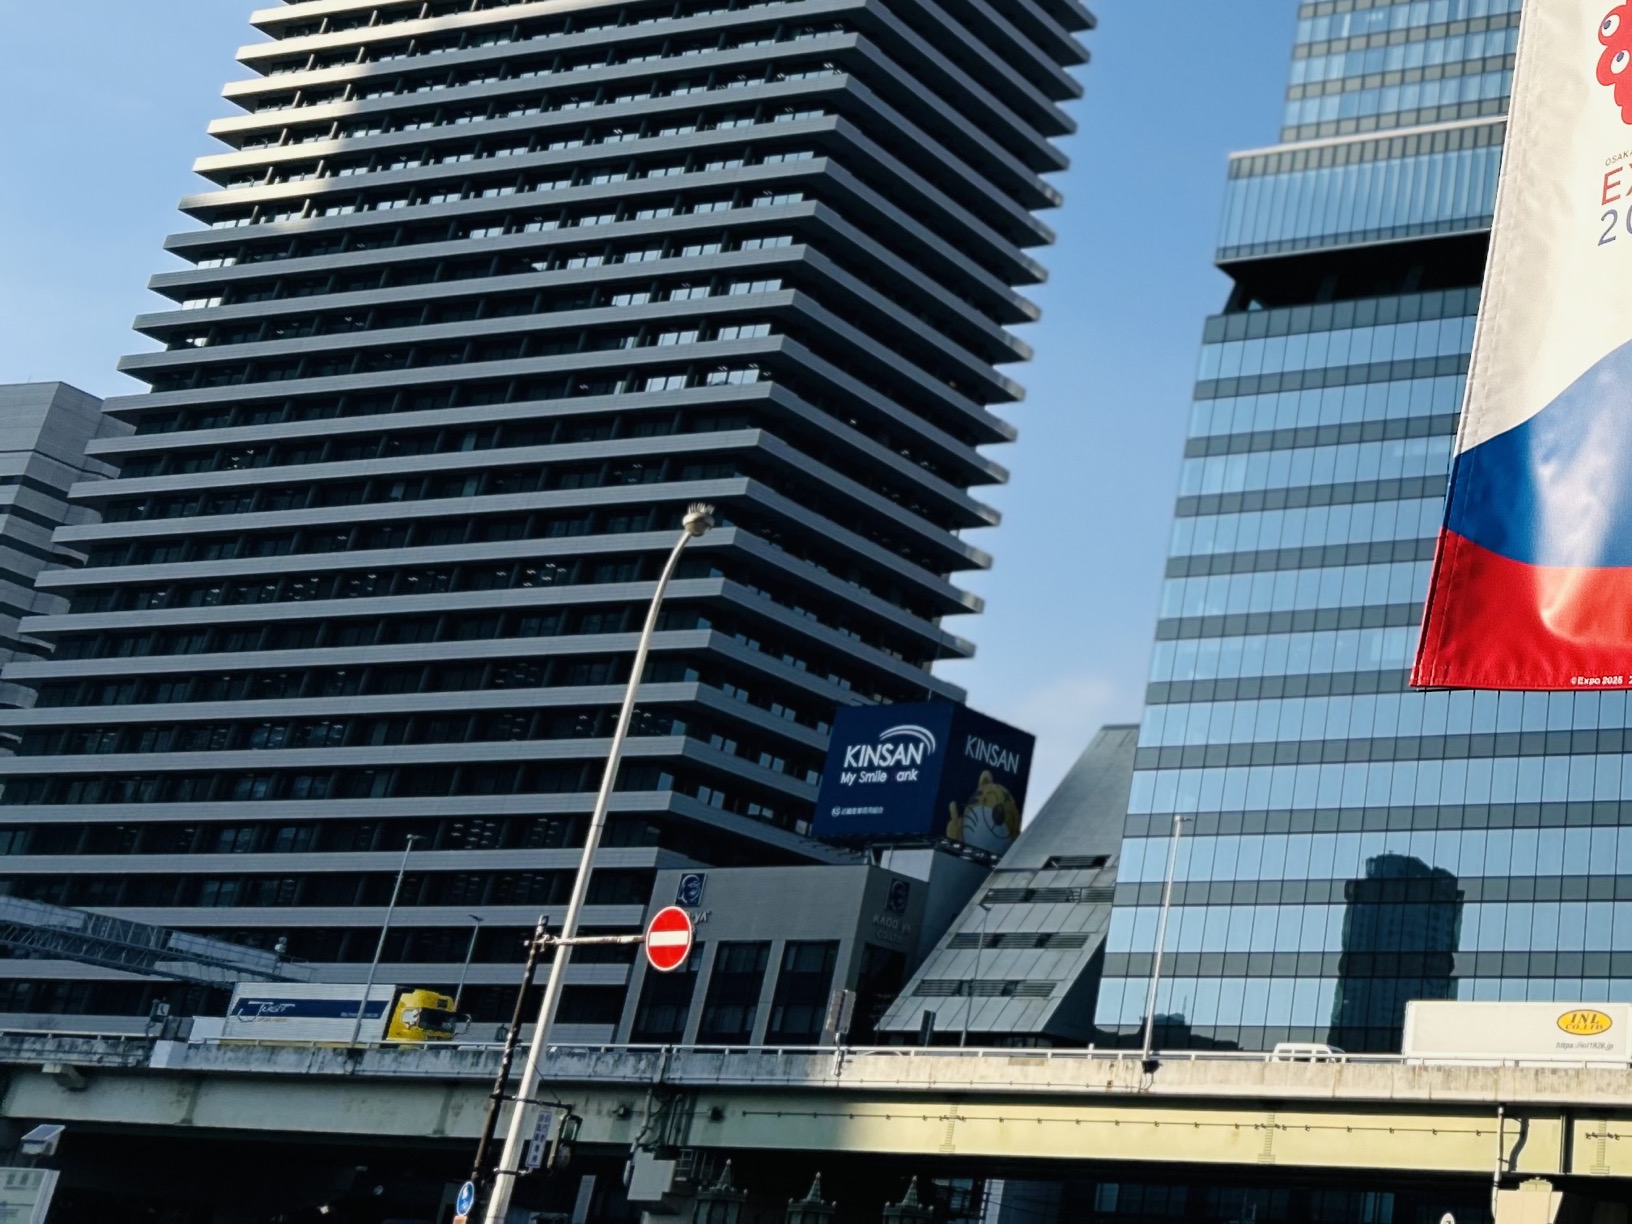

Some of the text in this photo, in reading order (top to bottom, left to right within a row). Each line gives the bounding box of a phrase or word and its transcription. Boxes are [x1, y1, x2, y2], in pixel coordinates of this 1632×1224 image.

[1602, 675, 1623, 685] 2025
[843, 742, 925, 768] KINSAN
[965, 734, 1020, 775] KINSAN
[840, 771, 857, 786] My
[859, 769, 887, 783] Smile
[1570, 1013, 1600, 1024] INL
